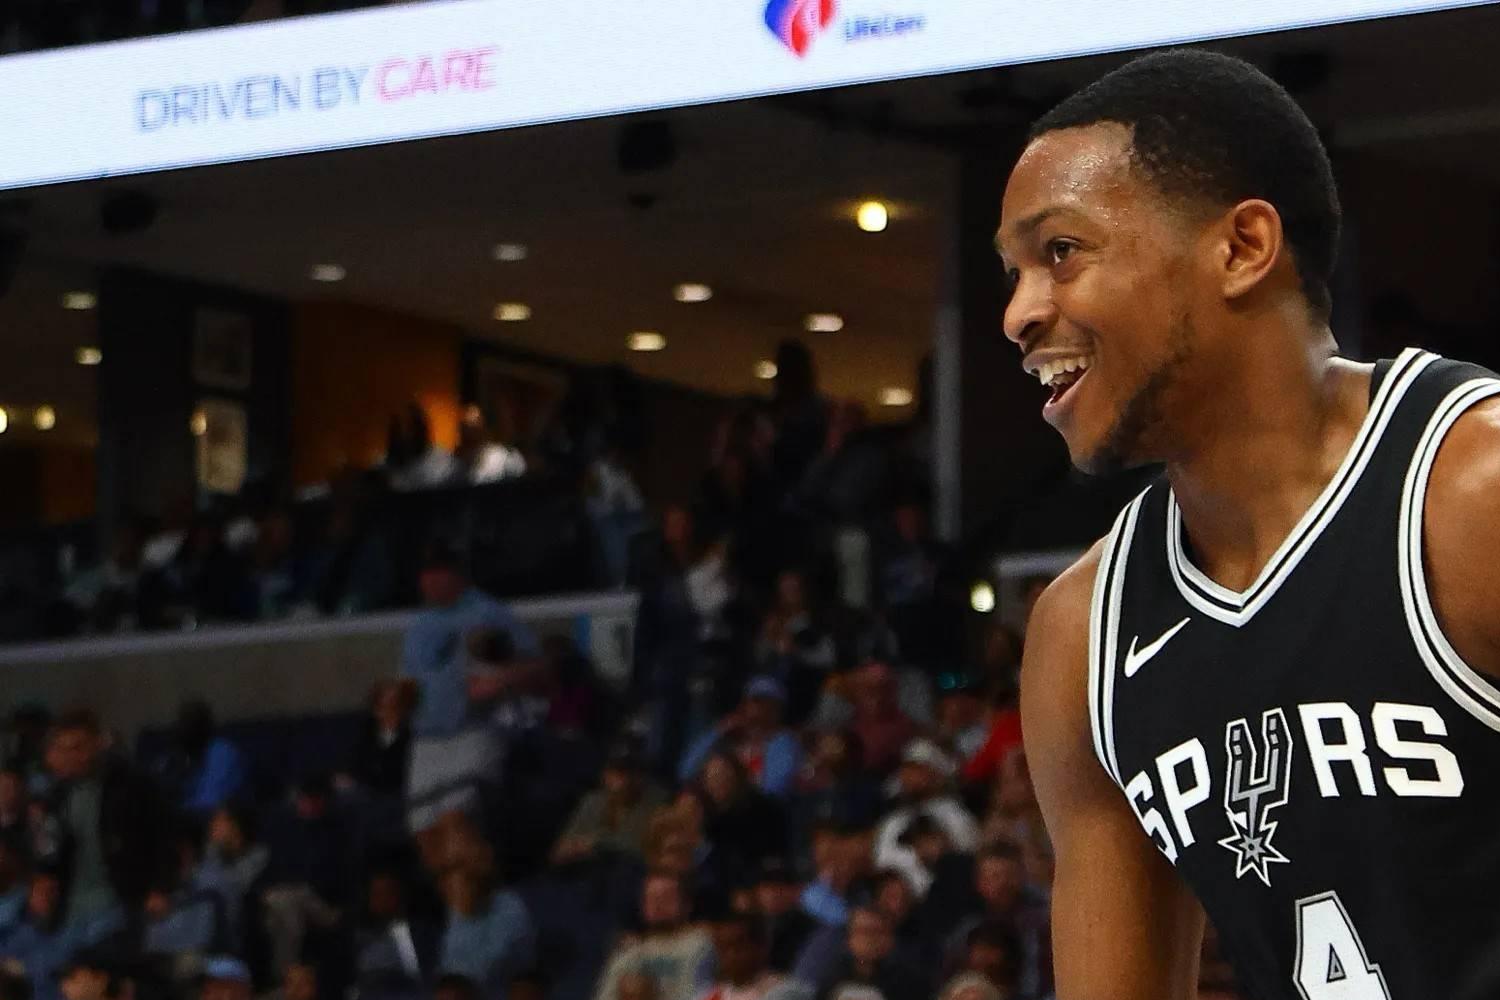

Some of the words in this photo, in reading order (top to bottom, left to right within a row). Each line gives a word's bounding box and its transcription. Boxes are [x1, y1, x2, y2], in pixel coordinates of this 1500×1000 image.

[138, 74, 301, 131] DRIVEN
[313, 66, 370, 111] BY
[377, 45, 500, 104] CARE
[1125, 702, 1465, 887] SPURS
